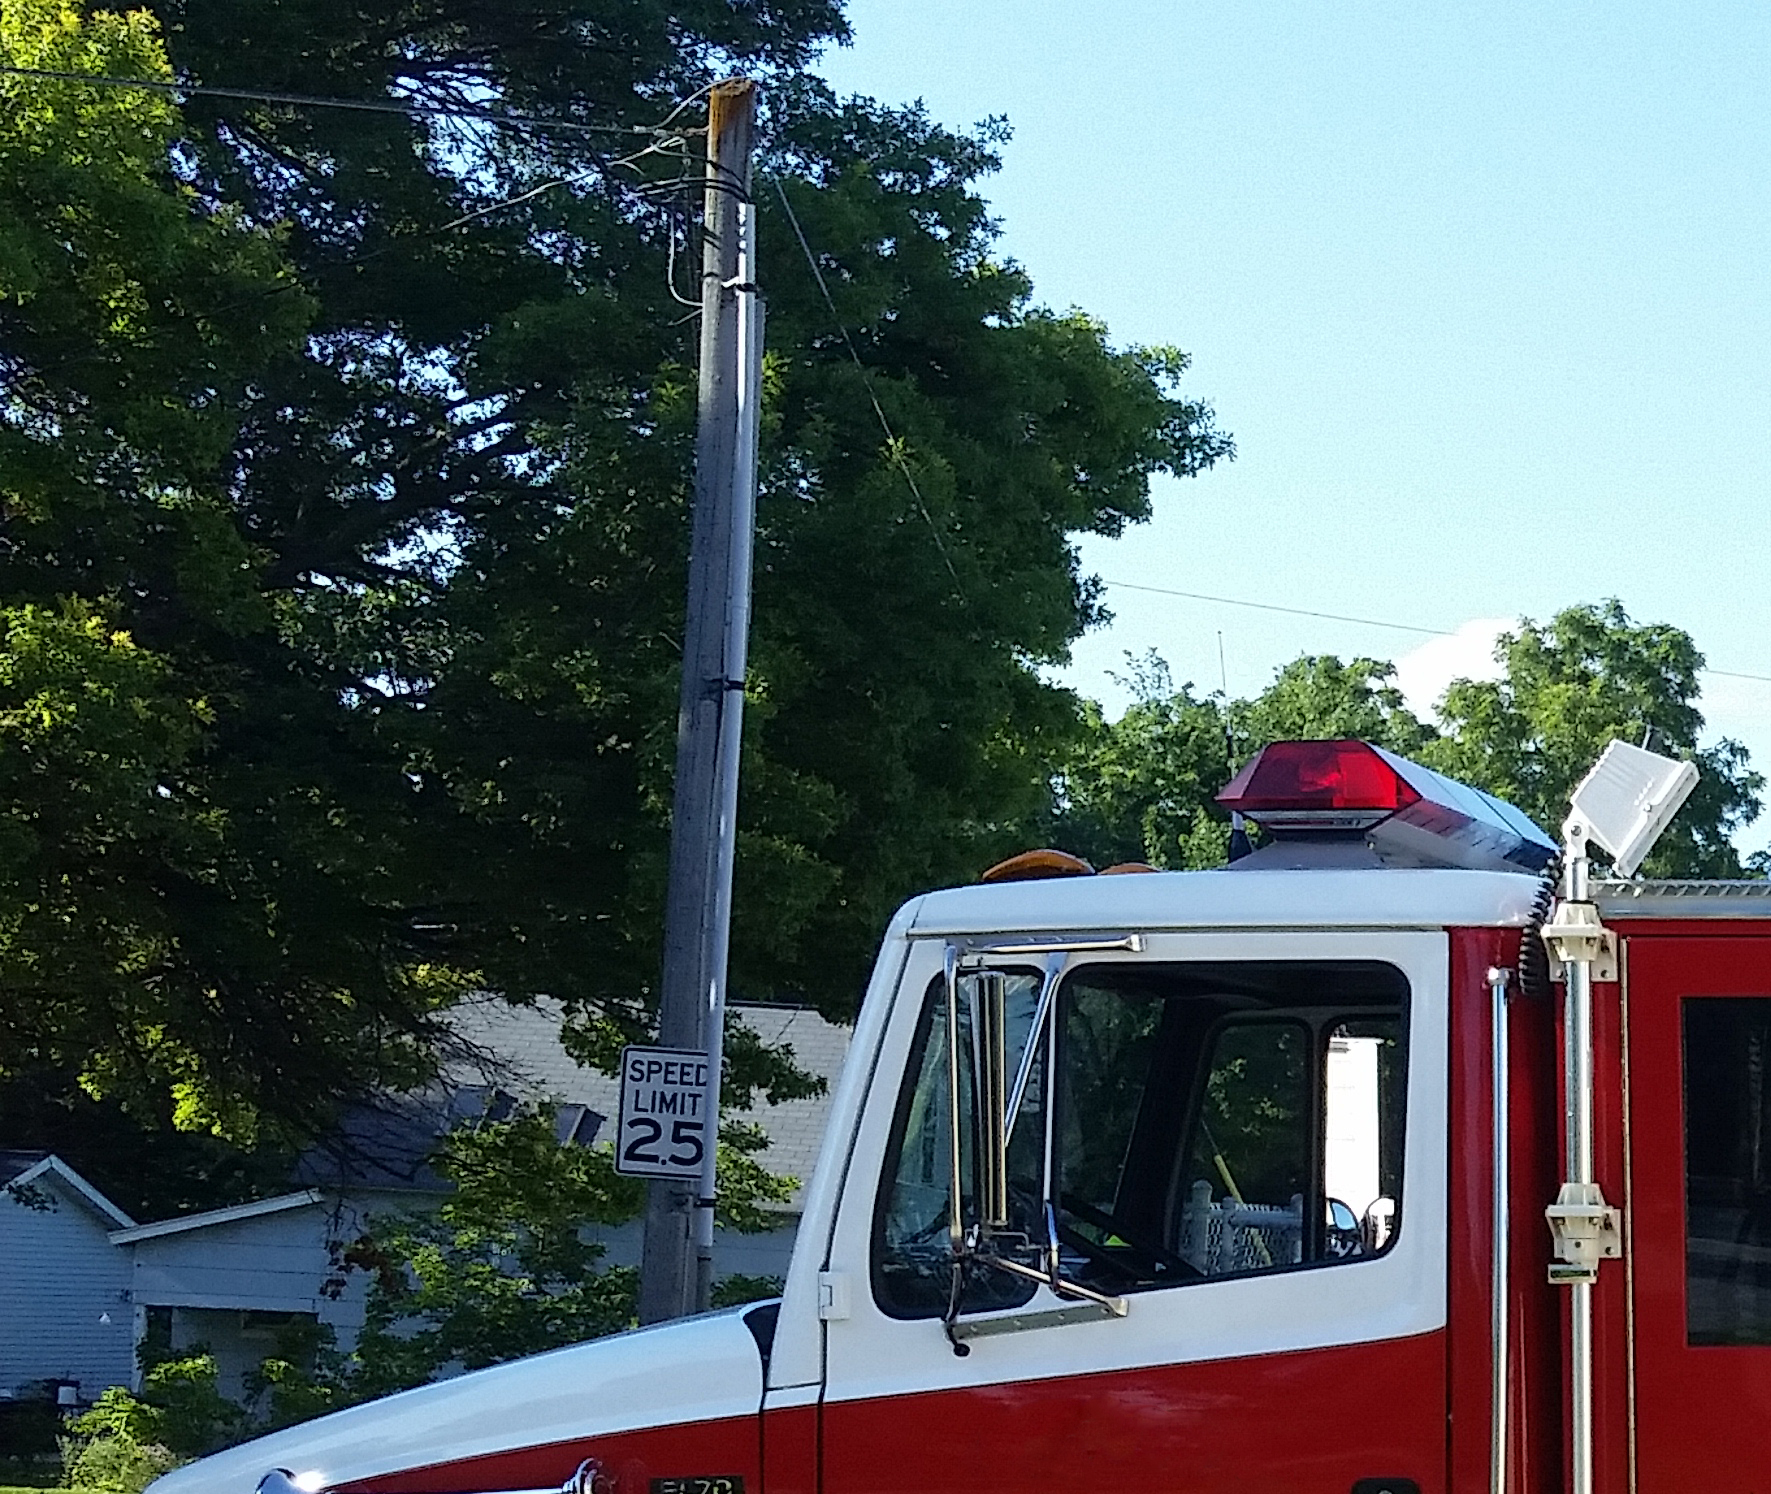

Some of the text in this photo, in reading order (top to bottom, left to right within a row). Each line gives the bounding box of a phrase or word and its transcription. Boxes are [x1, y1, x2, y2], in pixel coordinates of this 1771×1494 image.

[629, 1060, 708, 1087] SPEED
[634, 1089, 702, 1116] LIMIT
[624, 1117, 704, 1166] 25
